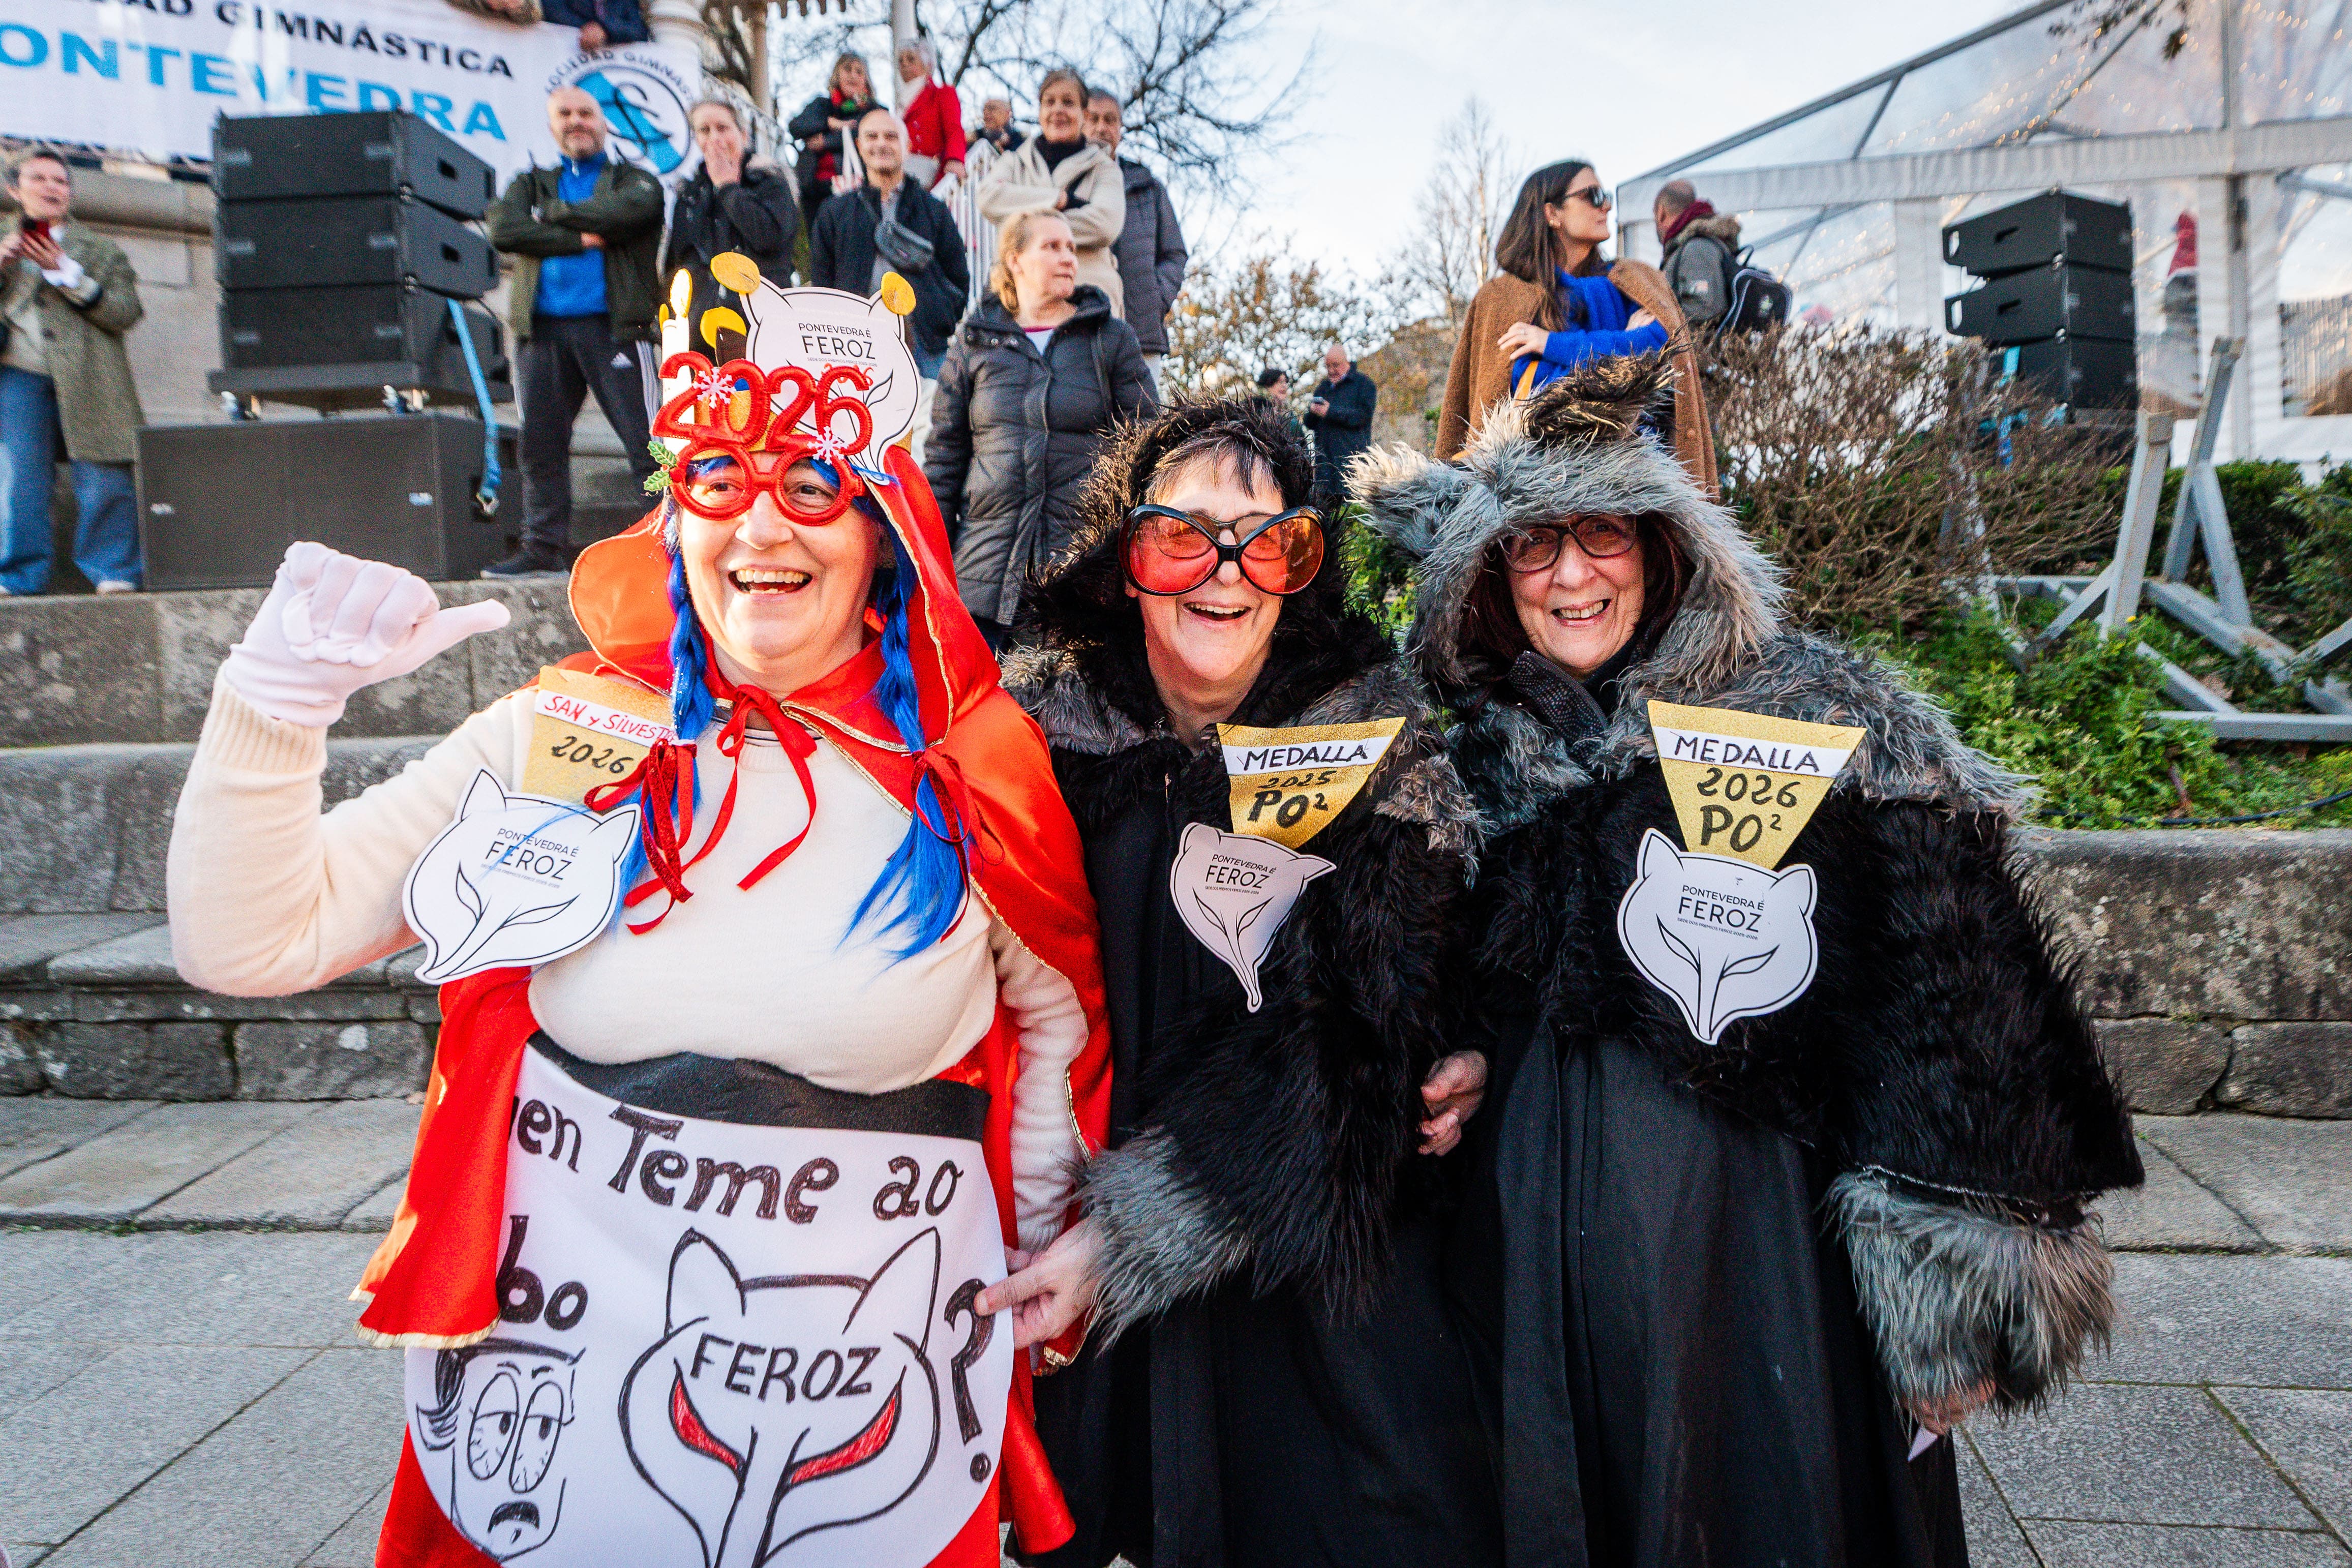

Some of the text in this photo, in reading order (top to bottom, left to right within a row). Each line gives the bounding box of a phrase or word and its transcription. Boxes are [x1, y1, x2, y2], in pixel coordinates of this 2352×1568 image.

[798, 322, 872, 338] PONTEVEDRA É
[801, 335, 876, 360] FEROZ
[650, 350, 873, 456] 2026
[545, 696, 588, 721] SAN
[551, 735, 635, 774] 2026
[1243, 744, 1368, 771] MEDALLA
[1673, 735, 1820, 773] MEDALLA
[1258, 770, 1338, 789] 2025
[1697, 767, 1801, 808] 2026
[497, 828, 580, 857] PONTEVEDRA É
[484, 840, 573, 881] FEROZ
[1212, 854, 1269, 873] PONTEVEDRA
[1205, 864, 1270, 889] FEROZ
[1682, 885, 1755, 910] PONTEVEDRA
[1678, 896, 1763, 933] FEROZ
[608, 1103, 840, 1225] Teme
[872, 1155, 964, 1220] ao
[689, 1333, 882, 1405] FEROZ
